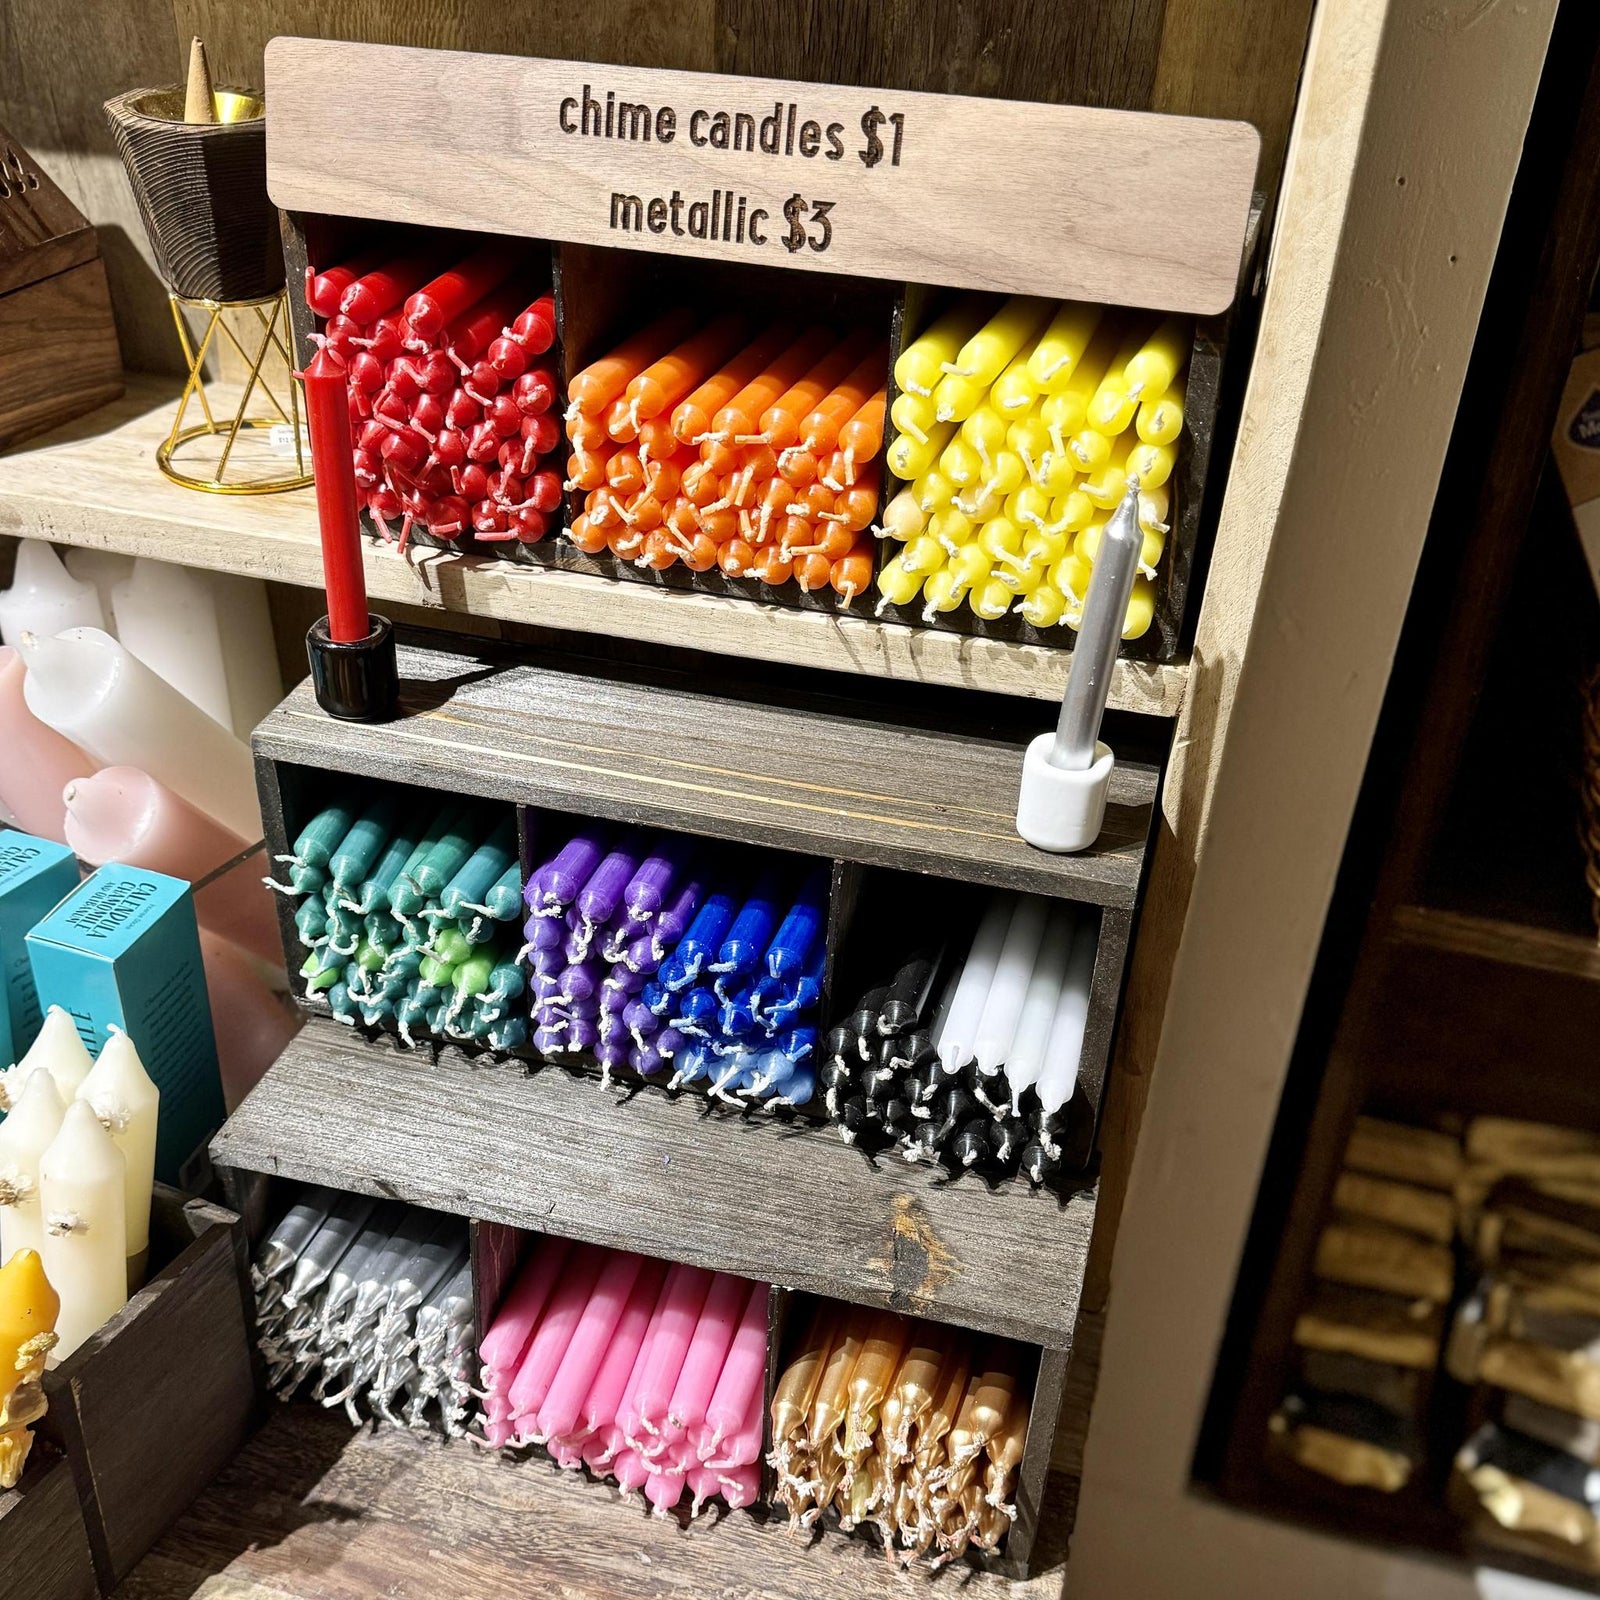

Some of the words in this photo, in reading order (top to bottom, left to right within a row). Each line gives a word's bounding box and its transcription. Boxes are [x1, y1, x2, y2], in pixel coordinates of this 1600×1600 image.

[559, 84, 677, 143] chime
[689, 102, 845, 161] candles
[858, 105, 905, 168] $1
[610, 189, 769, 245] metallic
[780, 193, 837, 253] $3
[73, 881, 136, 932] CHAMOMILE
[86, 882, 157, 938] CALENDULA
